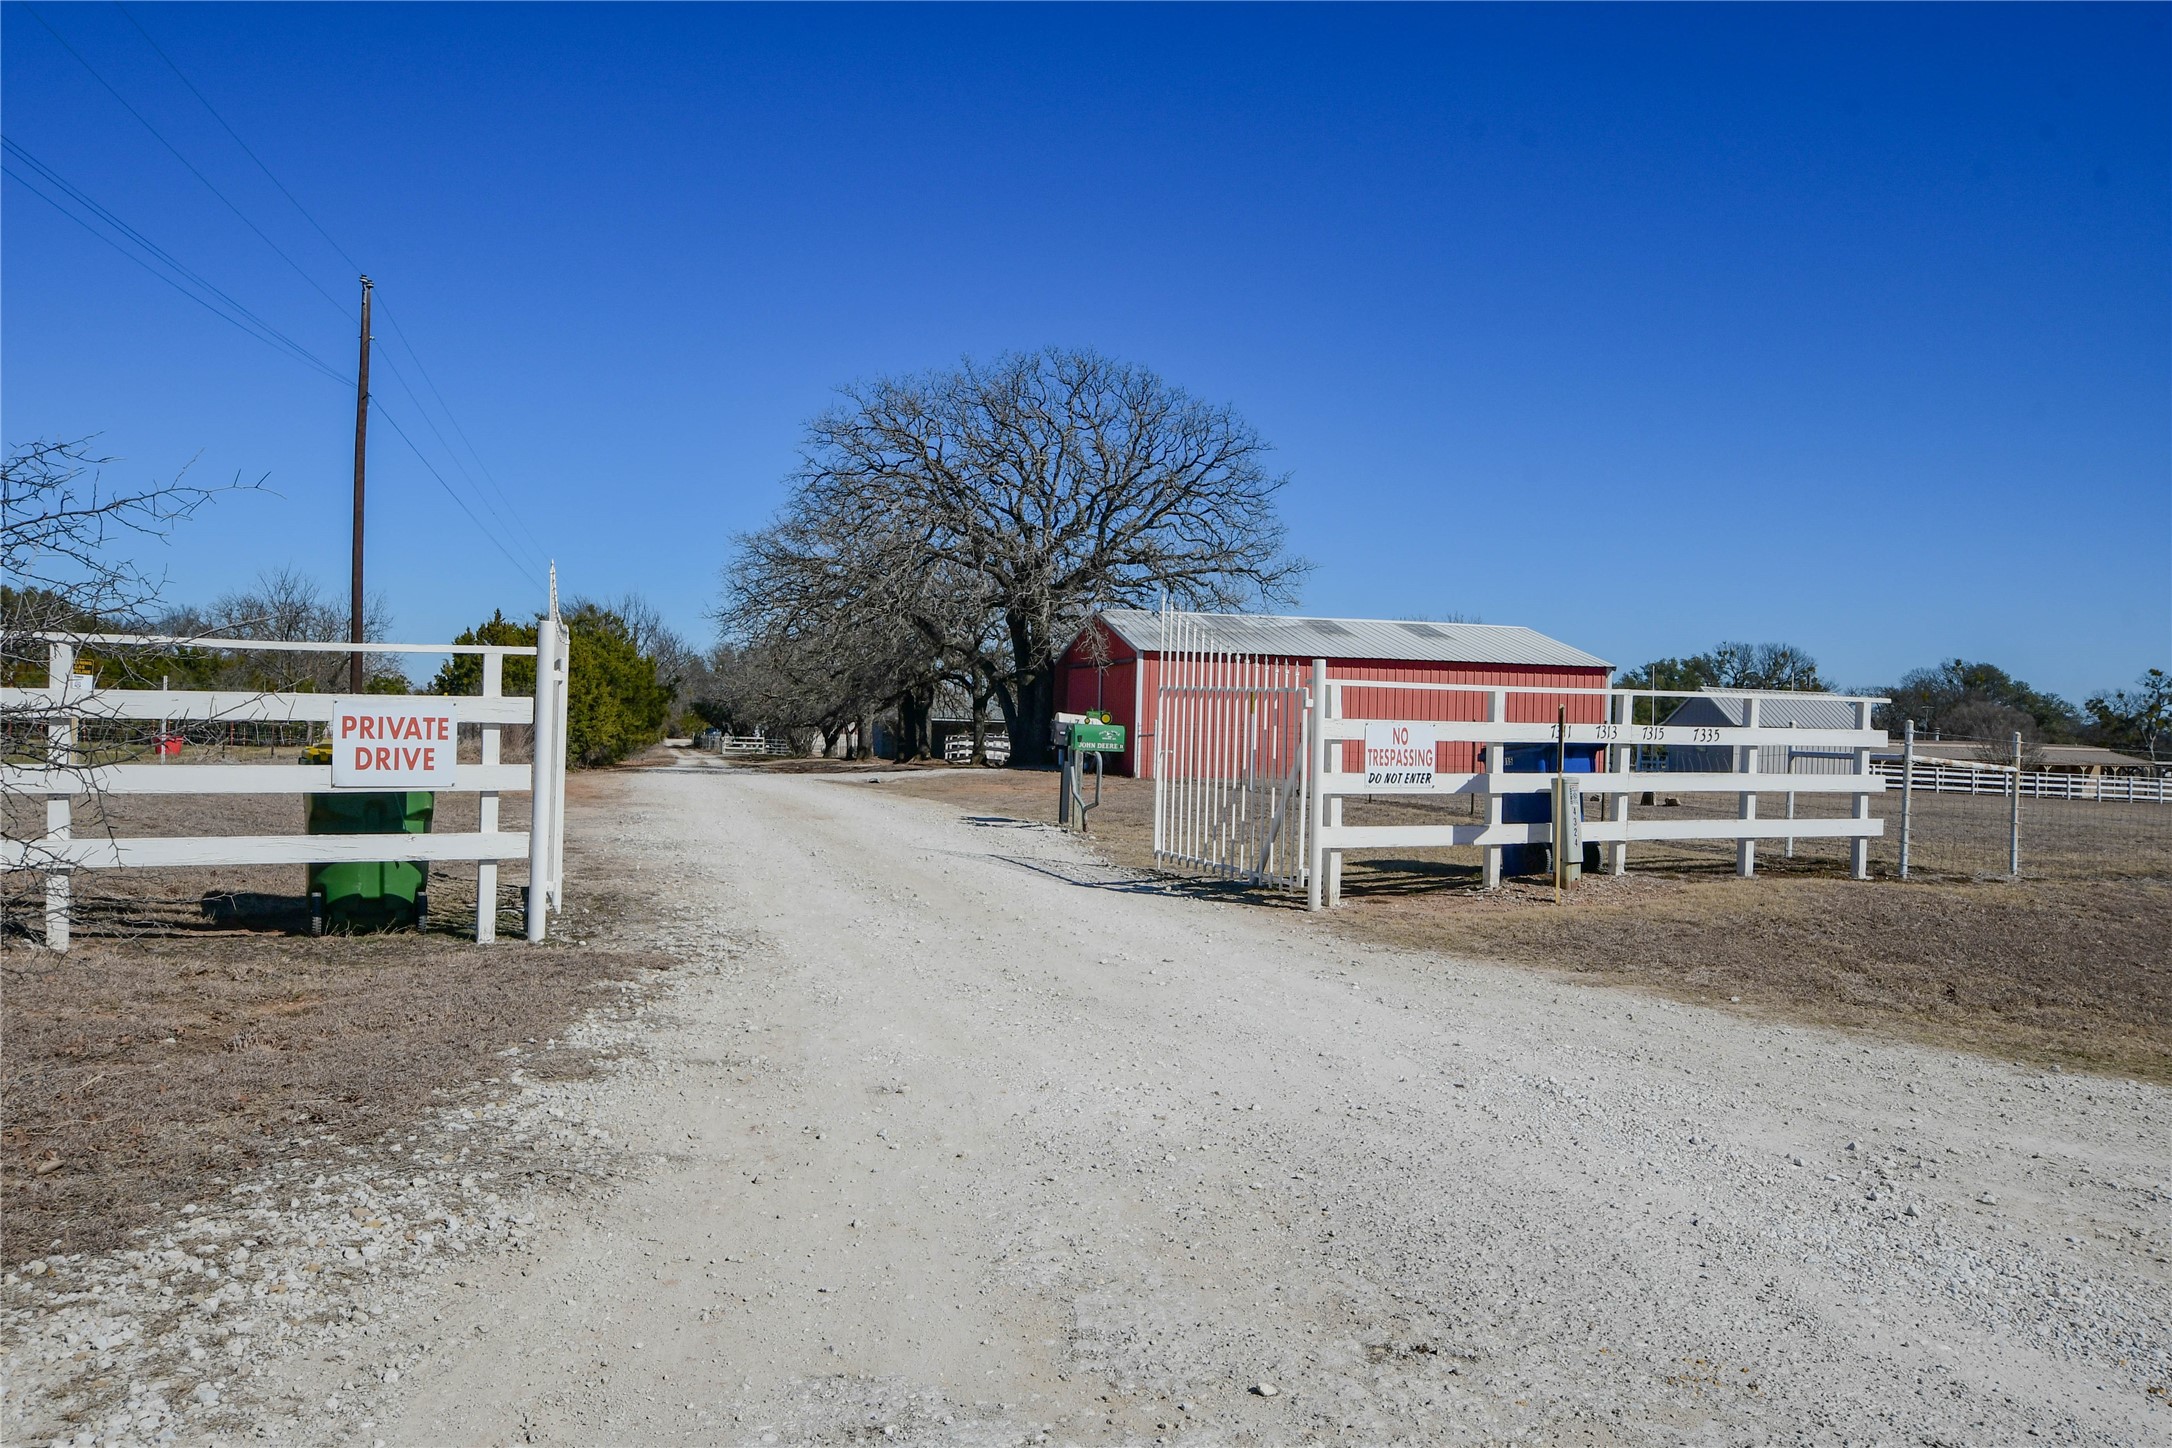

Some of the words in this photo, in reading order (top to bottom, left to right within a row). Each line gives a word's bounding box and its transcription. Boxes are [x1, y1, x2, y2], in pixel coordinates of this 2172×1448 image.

[342, 715, 449, 740] PRIVATE
[1595, 725, 1618, 739] 7313
[1642, 726, 1665, 740] 7315
[1393, 727, 1408, 745] NO
[1693, 728, 1720, 742] 7335
[1079, 741, 1096, 749] JOHN
[1097, 742, 1118, 750] DEERE
[355, 747, 435, 771] DRIVE
[1368, 749, 1433, 767] TRESPASSING
[1368, 772, 1382, 784] DO
[1384, 772, 1403, 784] NOT
[1404, 772, 1432, 784] ENTER
